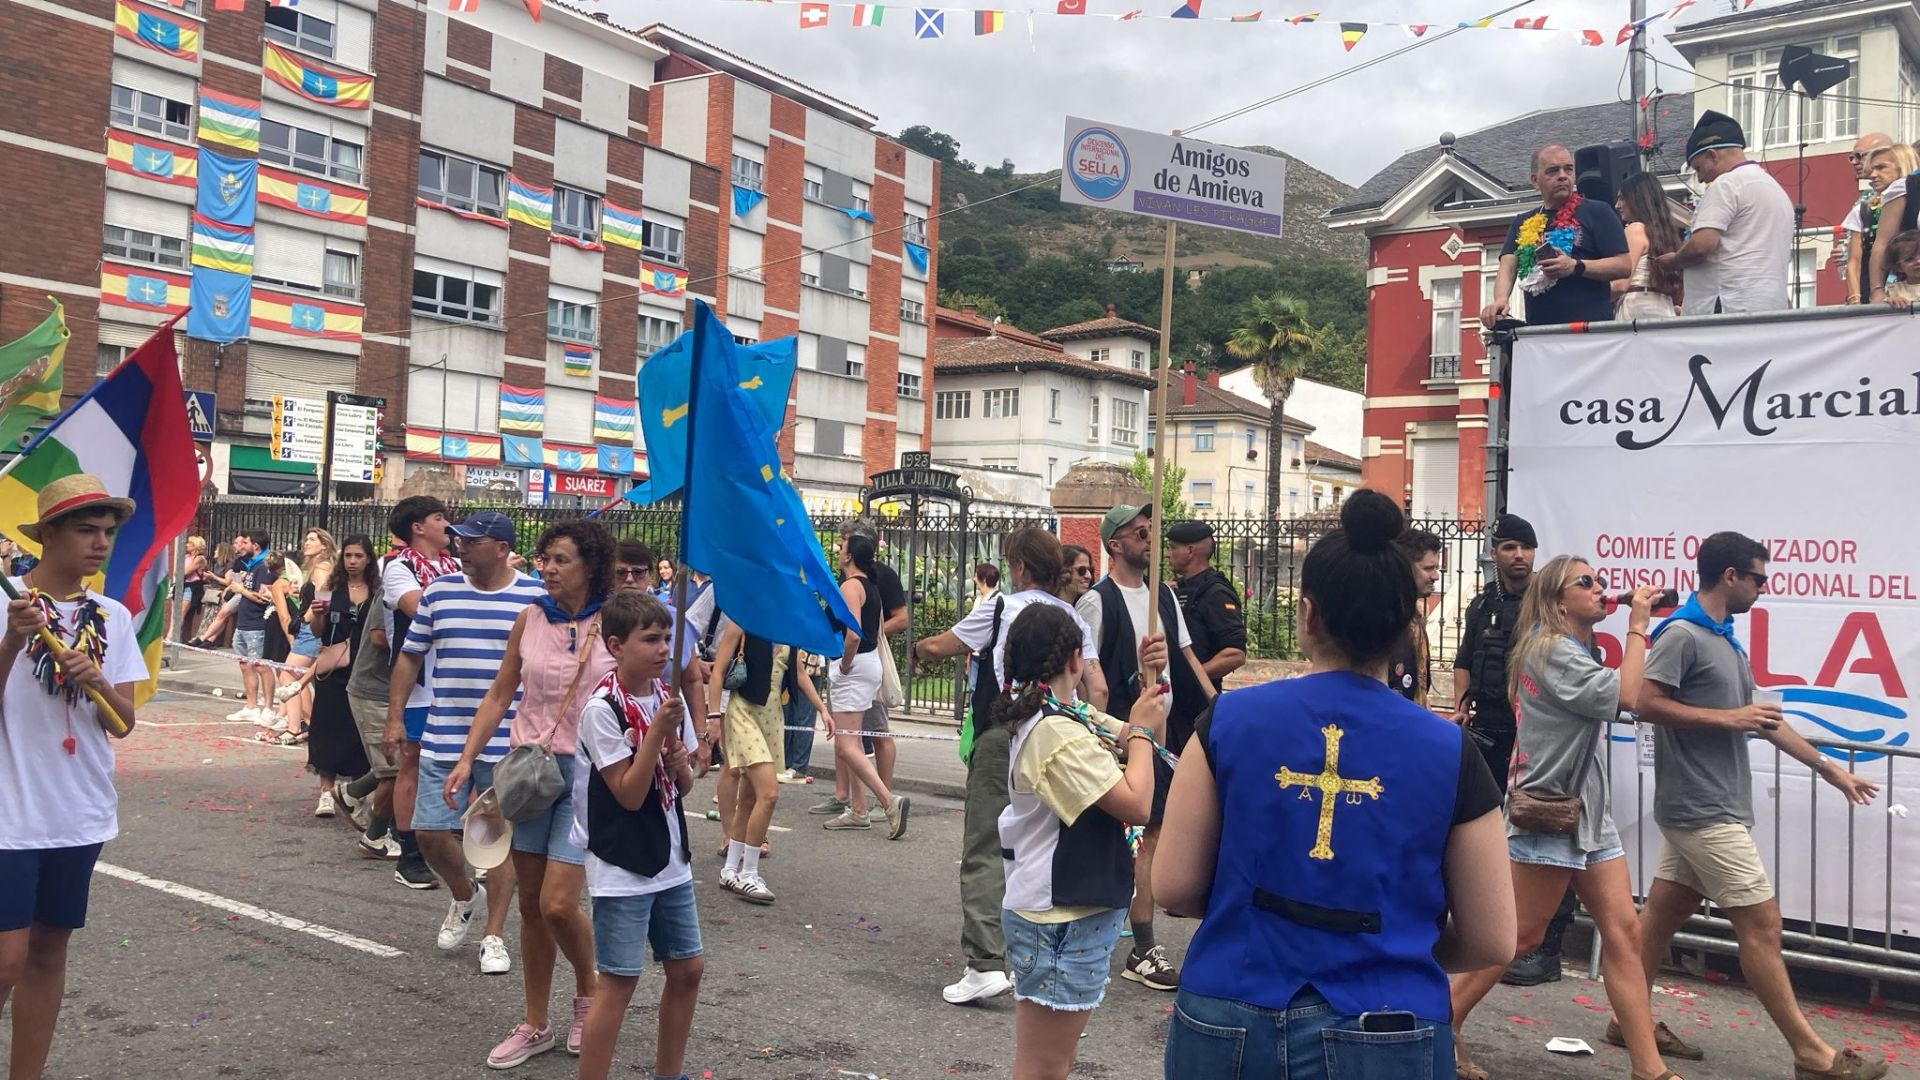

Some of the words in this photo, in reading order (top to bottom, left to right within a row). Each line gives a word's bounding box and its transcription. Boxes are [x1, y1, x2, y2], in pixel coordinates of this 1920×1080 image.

[1079, 158, 1120, 178] SELLA
[1170, 142, 1250, 178] Amigos
[1153, 168, 1181, 192] de
[1187, 173, 1264, 208] Amieva
[1559, 397, 1664, 426] casa
[1615, 353, 1920, 451] Marcial
[466, 467, 518, 479] Muebes
[902, 453, 929, 468] 1923
[874, 472, 904, 490] VILLA
[911, 471, 954, 490] JUANITA
[1597, 531, 1677, 560] COMITÉ
[1683, 534, 1858, 564] OIZADOR
[1869, 574, 1918, 600] DEL
